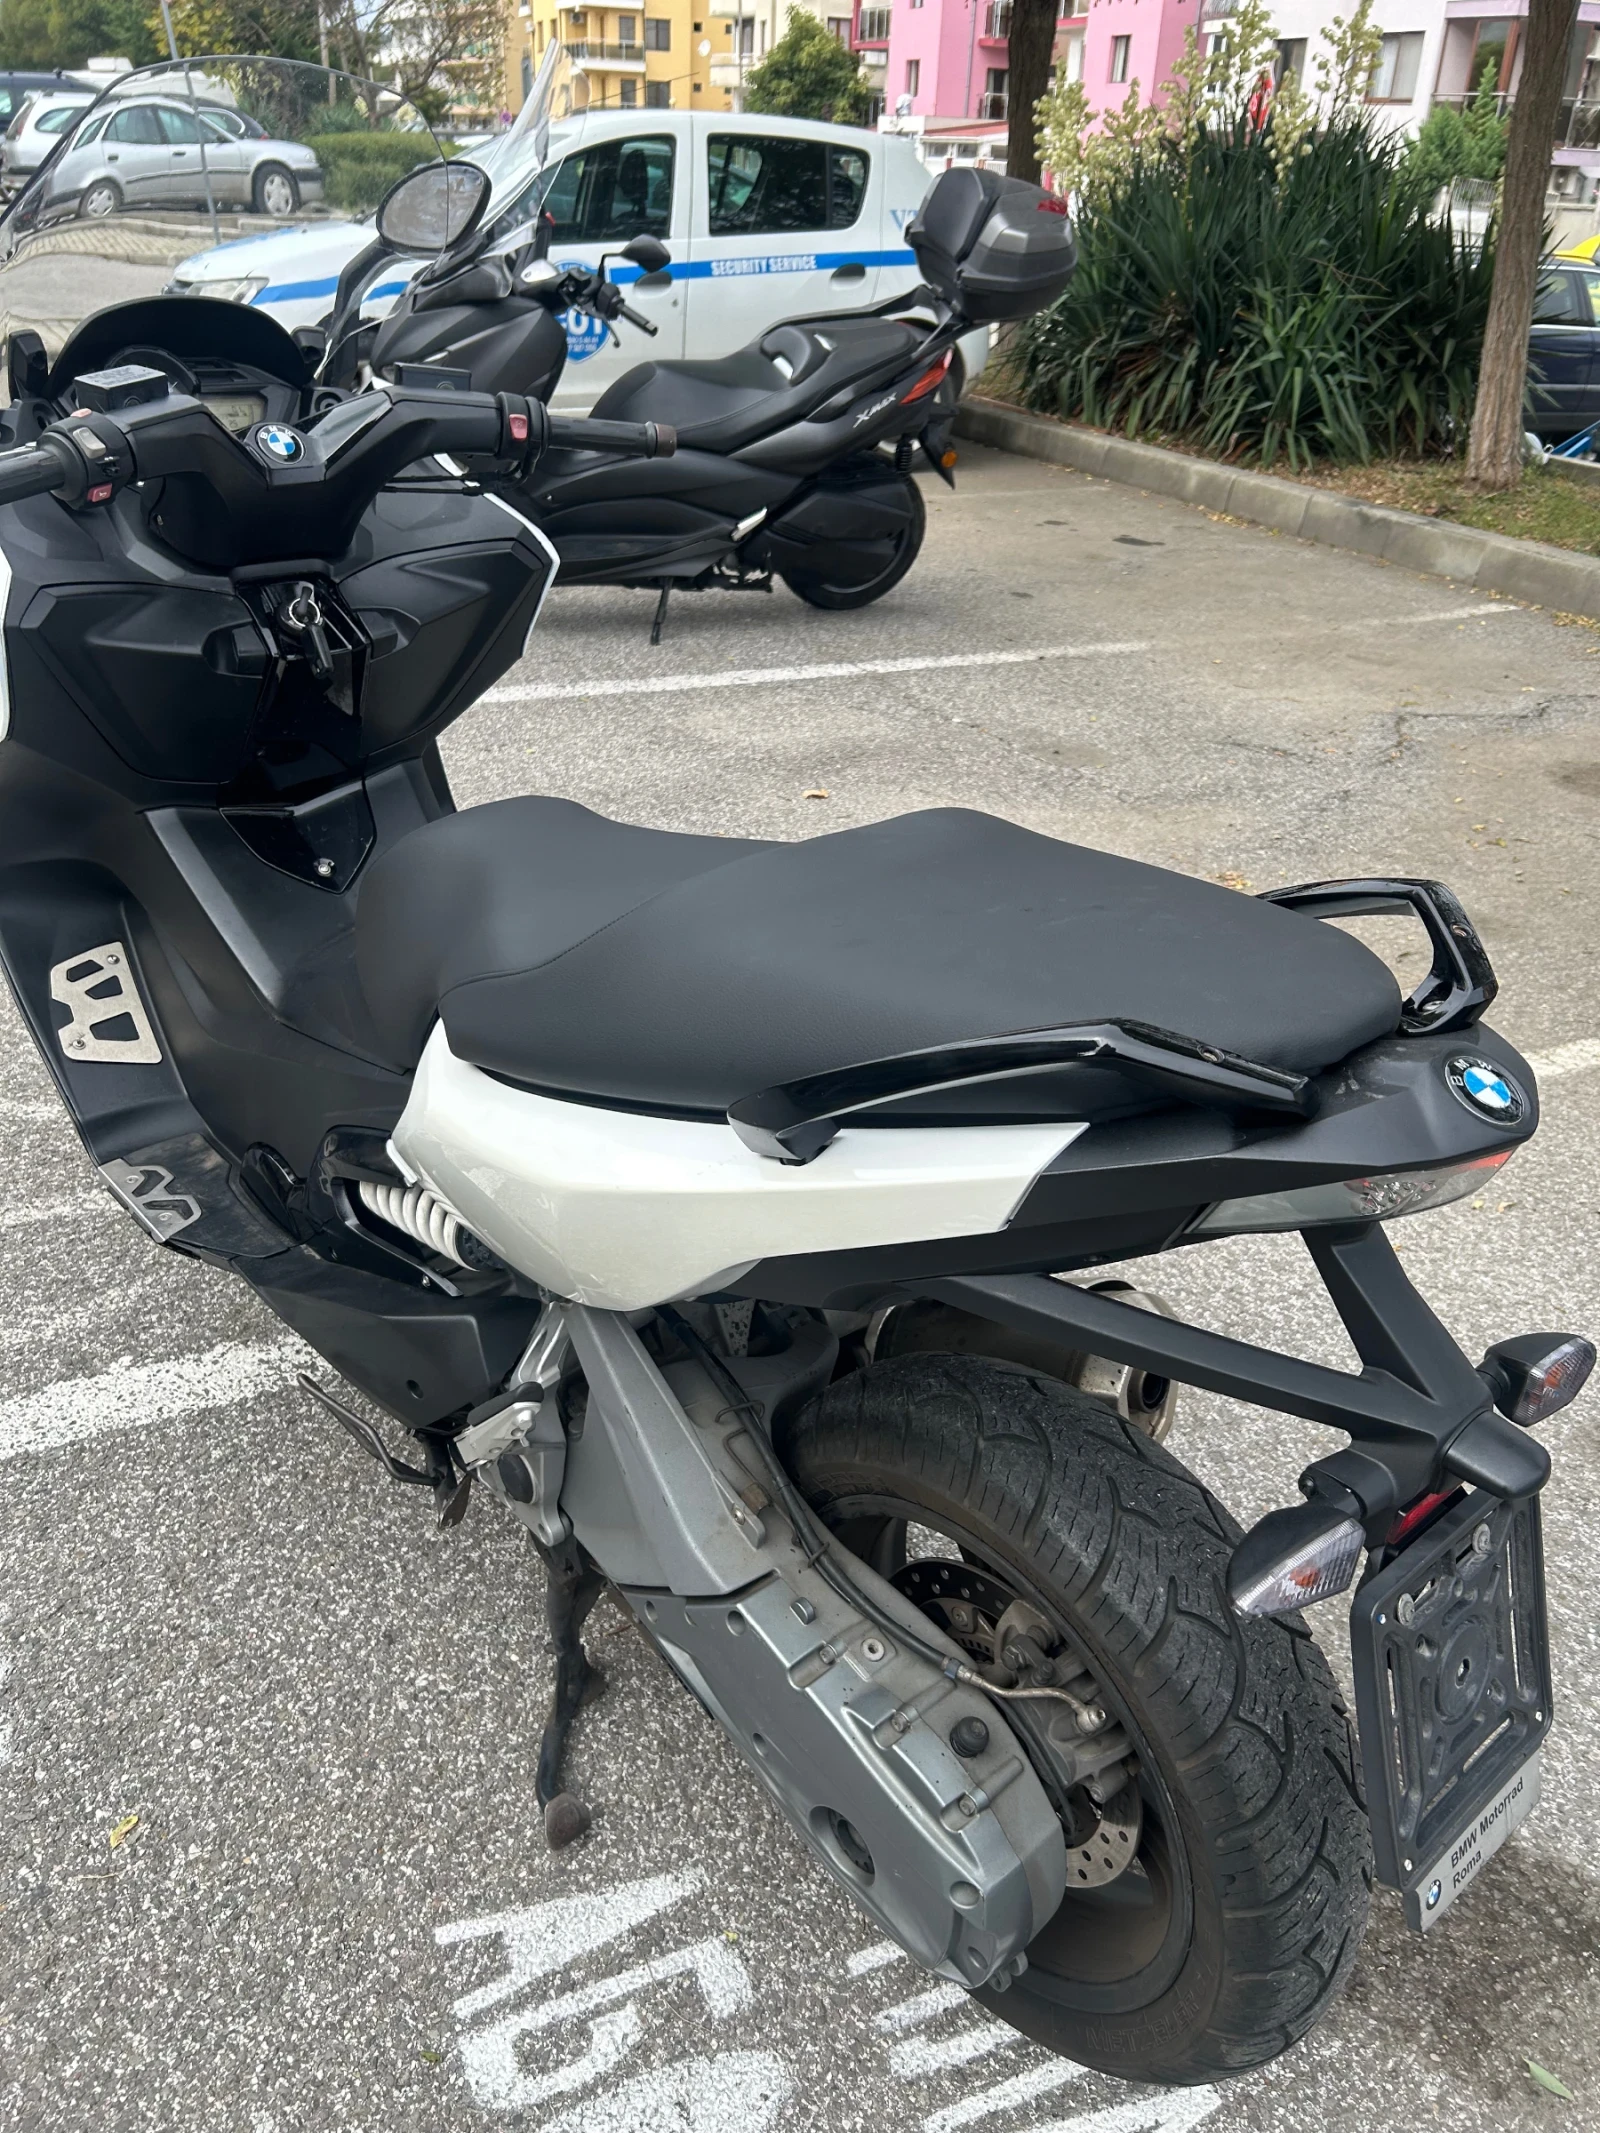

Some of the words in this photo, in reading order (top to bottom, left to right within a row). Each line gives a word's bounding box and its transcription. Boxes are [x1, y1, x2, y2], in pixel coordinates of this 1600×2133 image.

[711, 259, 767, 276] SECURITY
[768, 255, 817, 272] SERVICE
[260, 426, 294, 439] BMW
[1450, 1058, 1492, 1086] BMW
[1450, 1827, 1478, 1869] BMW
[1480, 1776, 1524, 1836] Motorrad
[1452, 1850, 1482, 1889] Roma
[1085, 1989, 1199, 2053] METZELER
